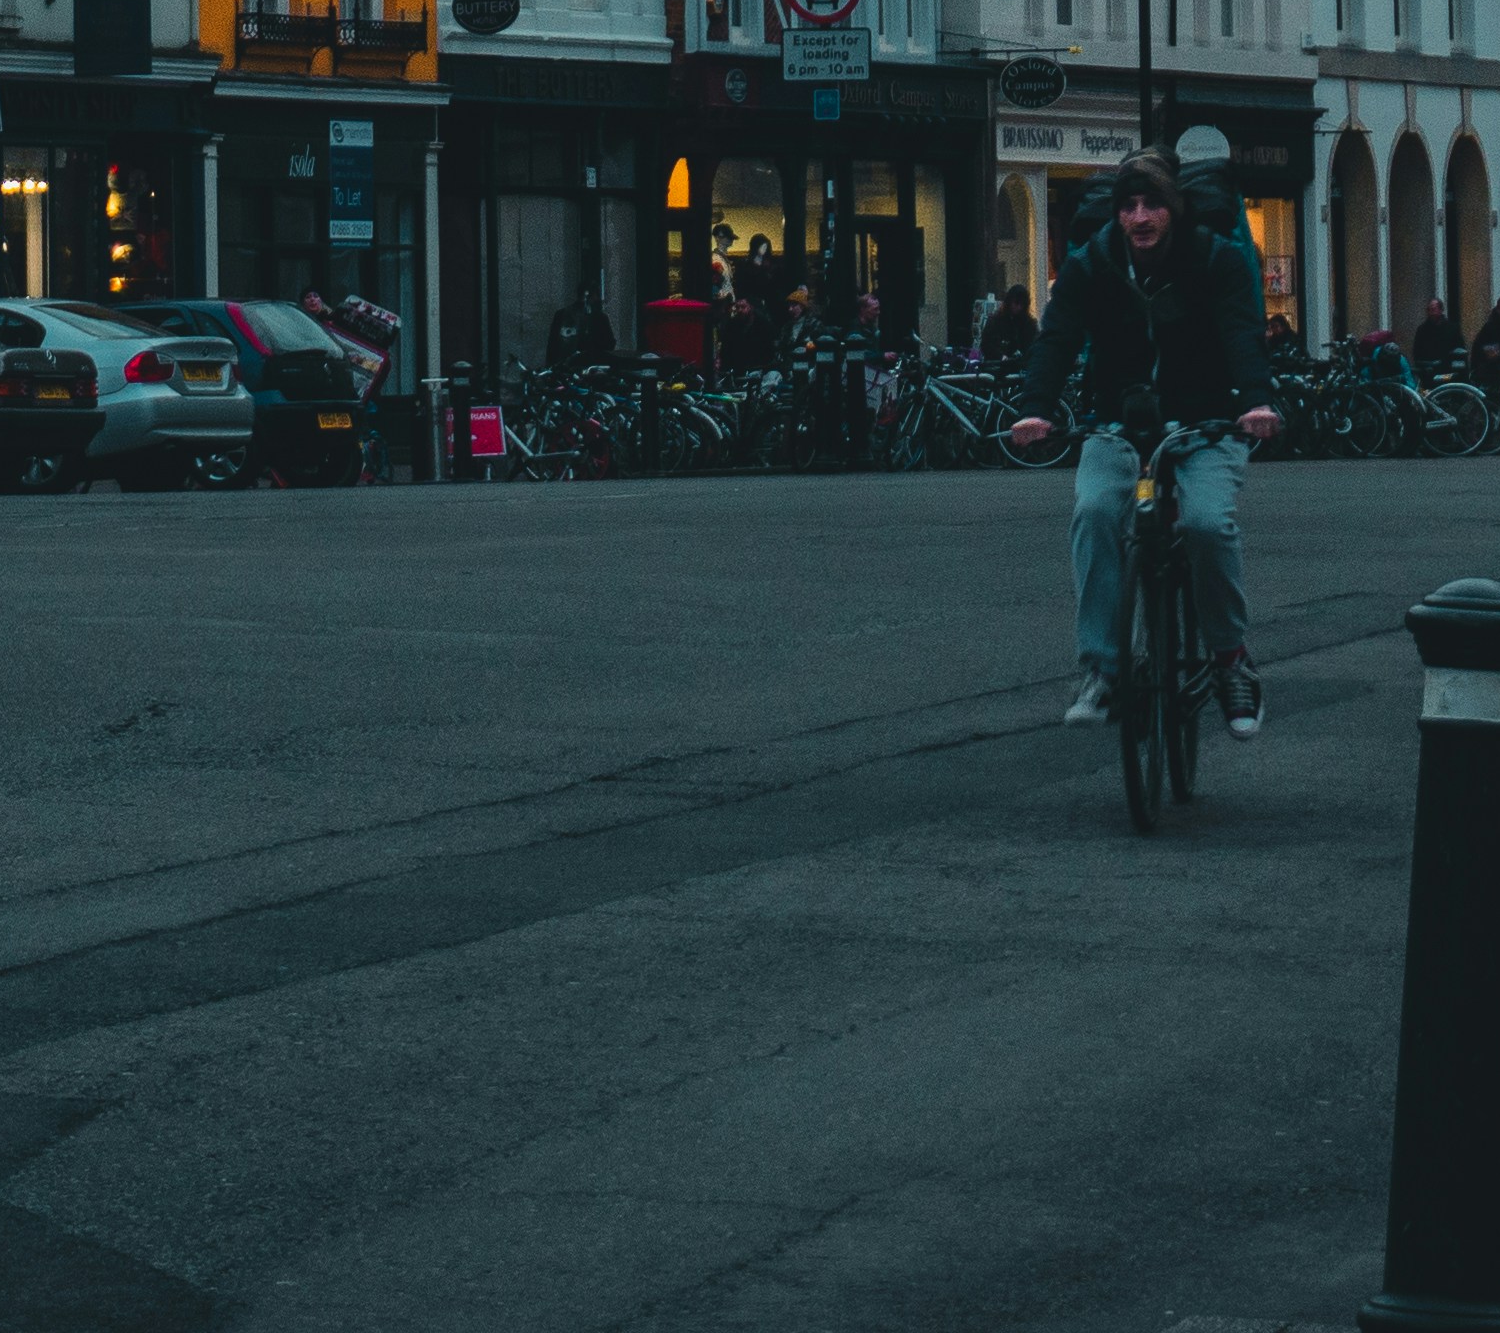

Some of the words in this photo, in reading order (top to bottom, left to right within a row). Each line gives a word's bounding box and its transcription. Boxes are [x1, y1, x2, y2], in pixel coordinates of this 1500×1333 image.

[455, 0, 515, 16] BUTTERY
[793, 35, 836, 48] Except
[842, 34, 859, 45] for
[803, 48, 849, 61] loading
[788, 63, 796, 75] 6
[799, 66, 819, 77] pm
[828, 64, 843, 75] 10
[846, 66, 865, 74] am
[1007, 59, 1057, 78] Oxford
[1005, 80, 1055, 93] Campus
[1002, 127, 1064, 152] BRAVISSIMO
[1081, 130, 1133, 155] Pepperberry
[333, 186, 345, 206] To
[347, 187, 362, 206] Let
